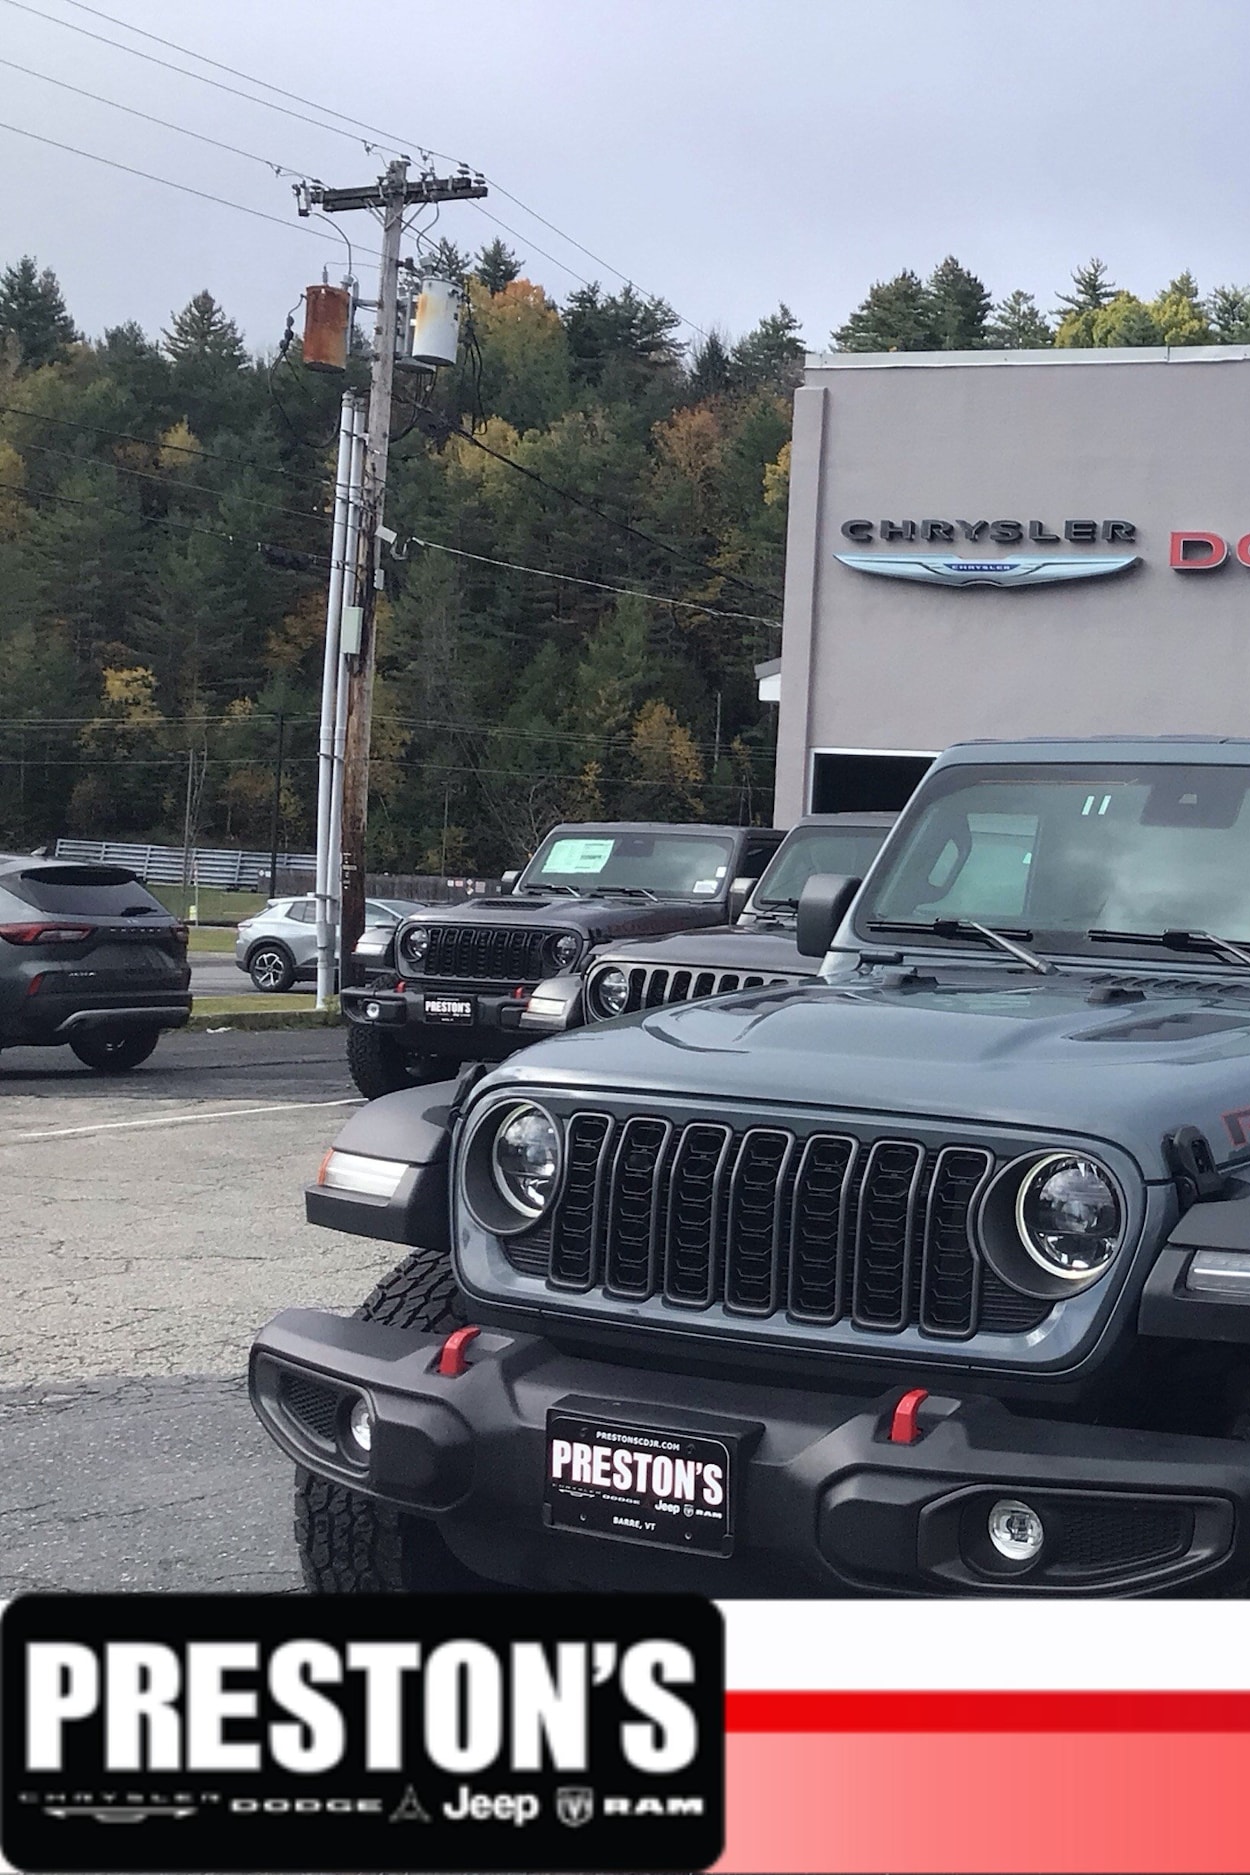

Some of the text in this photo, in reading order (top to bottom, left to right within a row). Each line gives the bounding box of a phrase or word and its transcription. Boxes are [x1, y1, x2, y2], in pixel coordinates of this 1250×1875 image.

[841, 518, 1137, 543] CHRYSLER
[425, 1000, 471, 1014] PRESTON'S
[596, 1430, 681, 1451] PRESTONSCDJR.COM
[552, 1439, 723, 1506] PRESTON'S
[654, 1499, 681, 1516] Jeep
[695, 1508, 723, 1519] RAM
[612, 1516, 656, 1531] BARRE, VT
